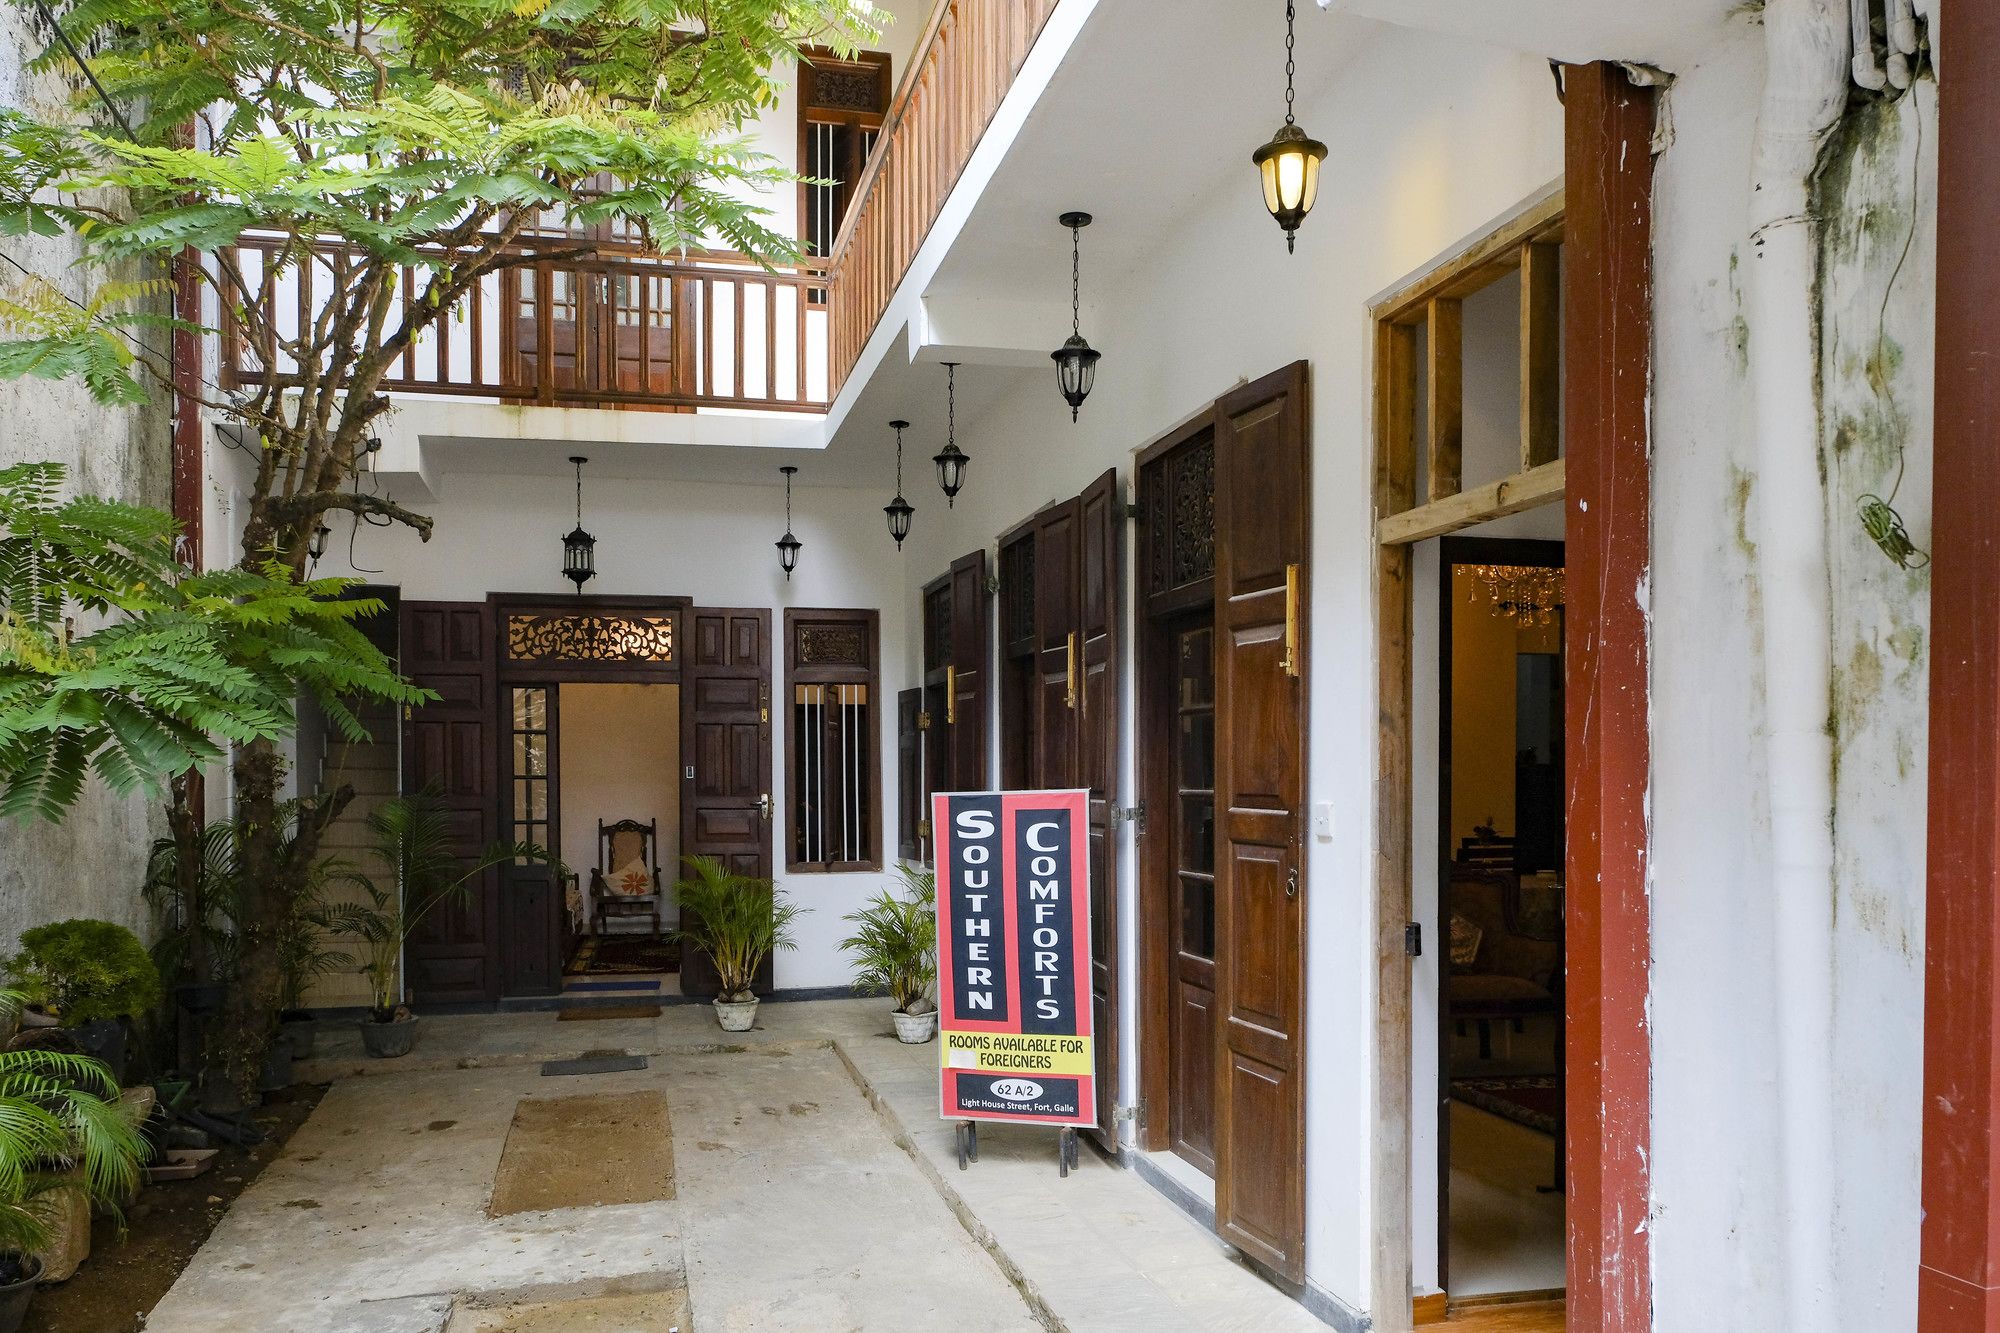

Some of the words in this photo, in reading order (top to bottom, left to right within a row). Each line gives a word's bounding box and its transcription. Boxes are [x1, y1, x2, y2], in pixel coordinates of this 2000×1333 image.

[956, 809, 995, 1011] SOUTHERN
[1025, 822, 1060, 1020] COMFORTS
[949, 1034, 990, 1049] ROOMS
[993, 1036, 1057, 1052] AVAILABLE
[1060, 1039, 1084, 1053] FOR
[980, 1052, 1052, 1069] FOREIGNERS
[997, 1084, 1012, 1095] 62
[1014, 1085, 1034, 1097] A/2
[961, 1098, 980, 1108] Light
[981, 1099, 1005, 1109] House
[1006, 1101, 1033, 1111] Street,
[1034, 1103, 1053, 1112] Fort,
[1054, 1103, 1074, 1113] Galle
